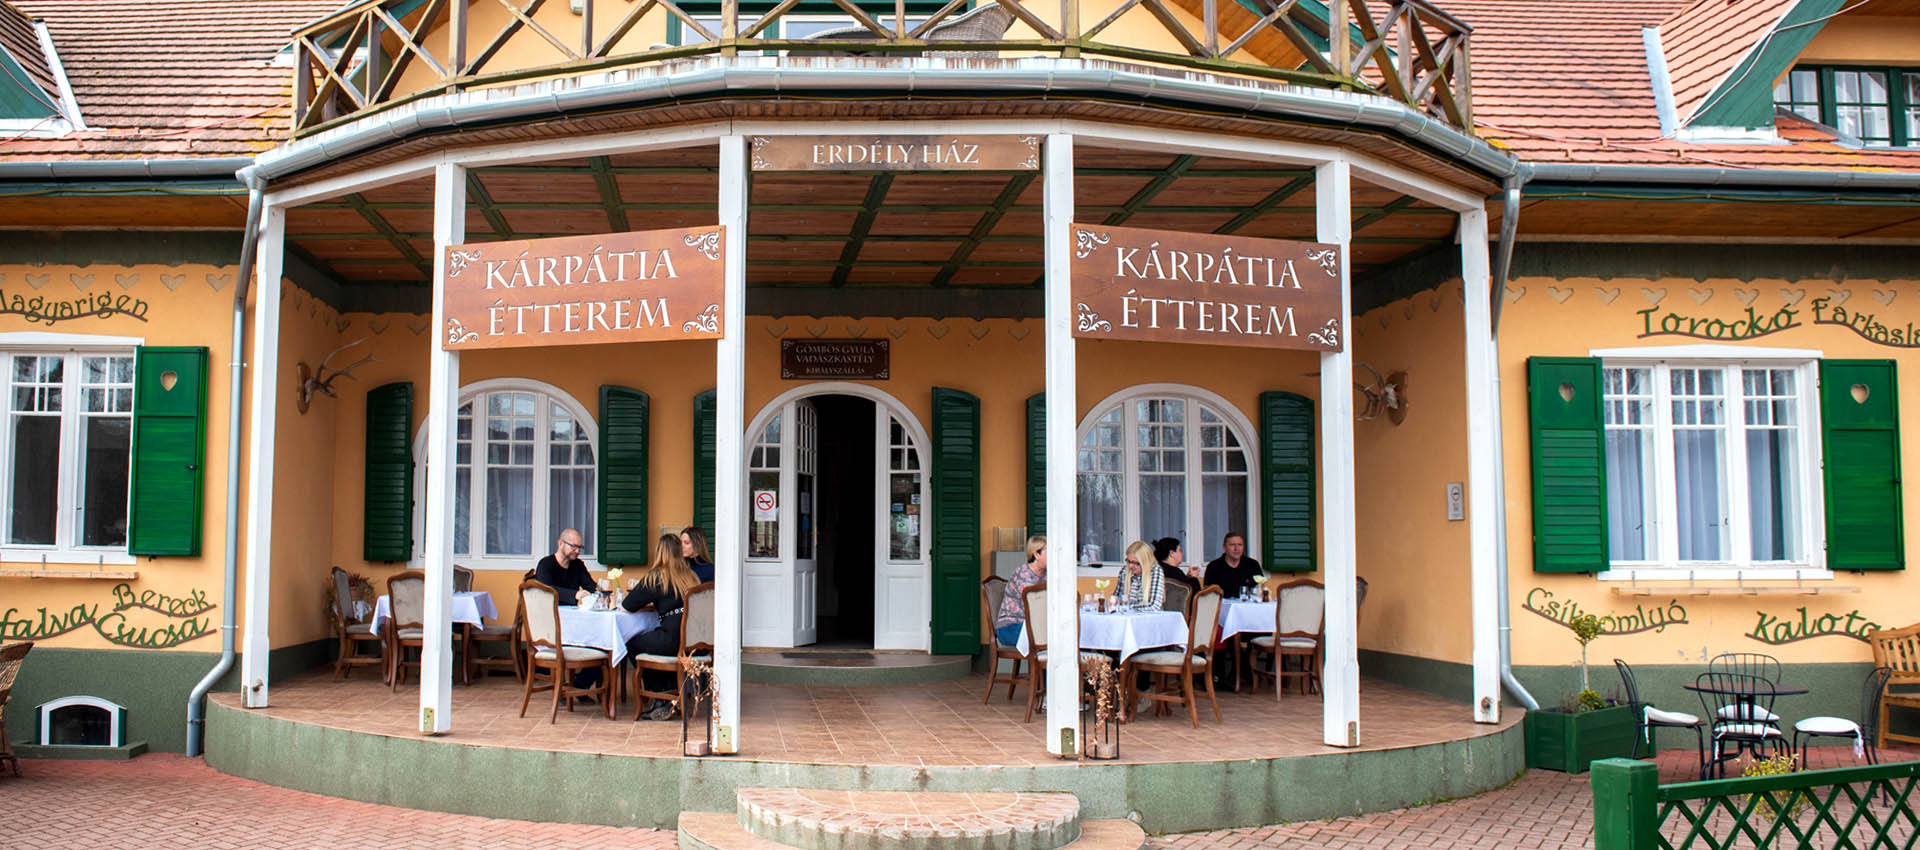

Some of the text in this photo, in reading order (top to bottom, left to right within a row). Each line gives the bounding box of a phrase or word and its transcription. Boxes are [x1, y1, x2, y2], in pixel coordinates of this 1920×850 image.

[812, 139, 980, 165] ERDÉLY HÁZ
[482, 246, 680, 290] KÁRPÁTIA
[1113, 241, 1303, 290] KÁRPÁTIA
[486, 298, 673, 336] ÉTTEREM
[1119, 288, 1299, 337] ÉTTEREM
[1636, 303, 1800, 340] Torockó
[841, 345, 875, 354] GYULA
[112, 583, 210, 618] Bereck
[1526, 587, 1688, 634] Csíkomlyó
[1753, 606, 1884, 646] Kalota
